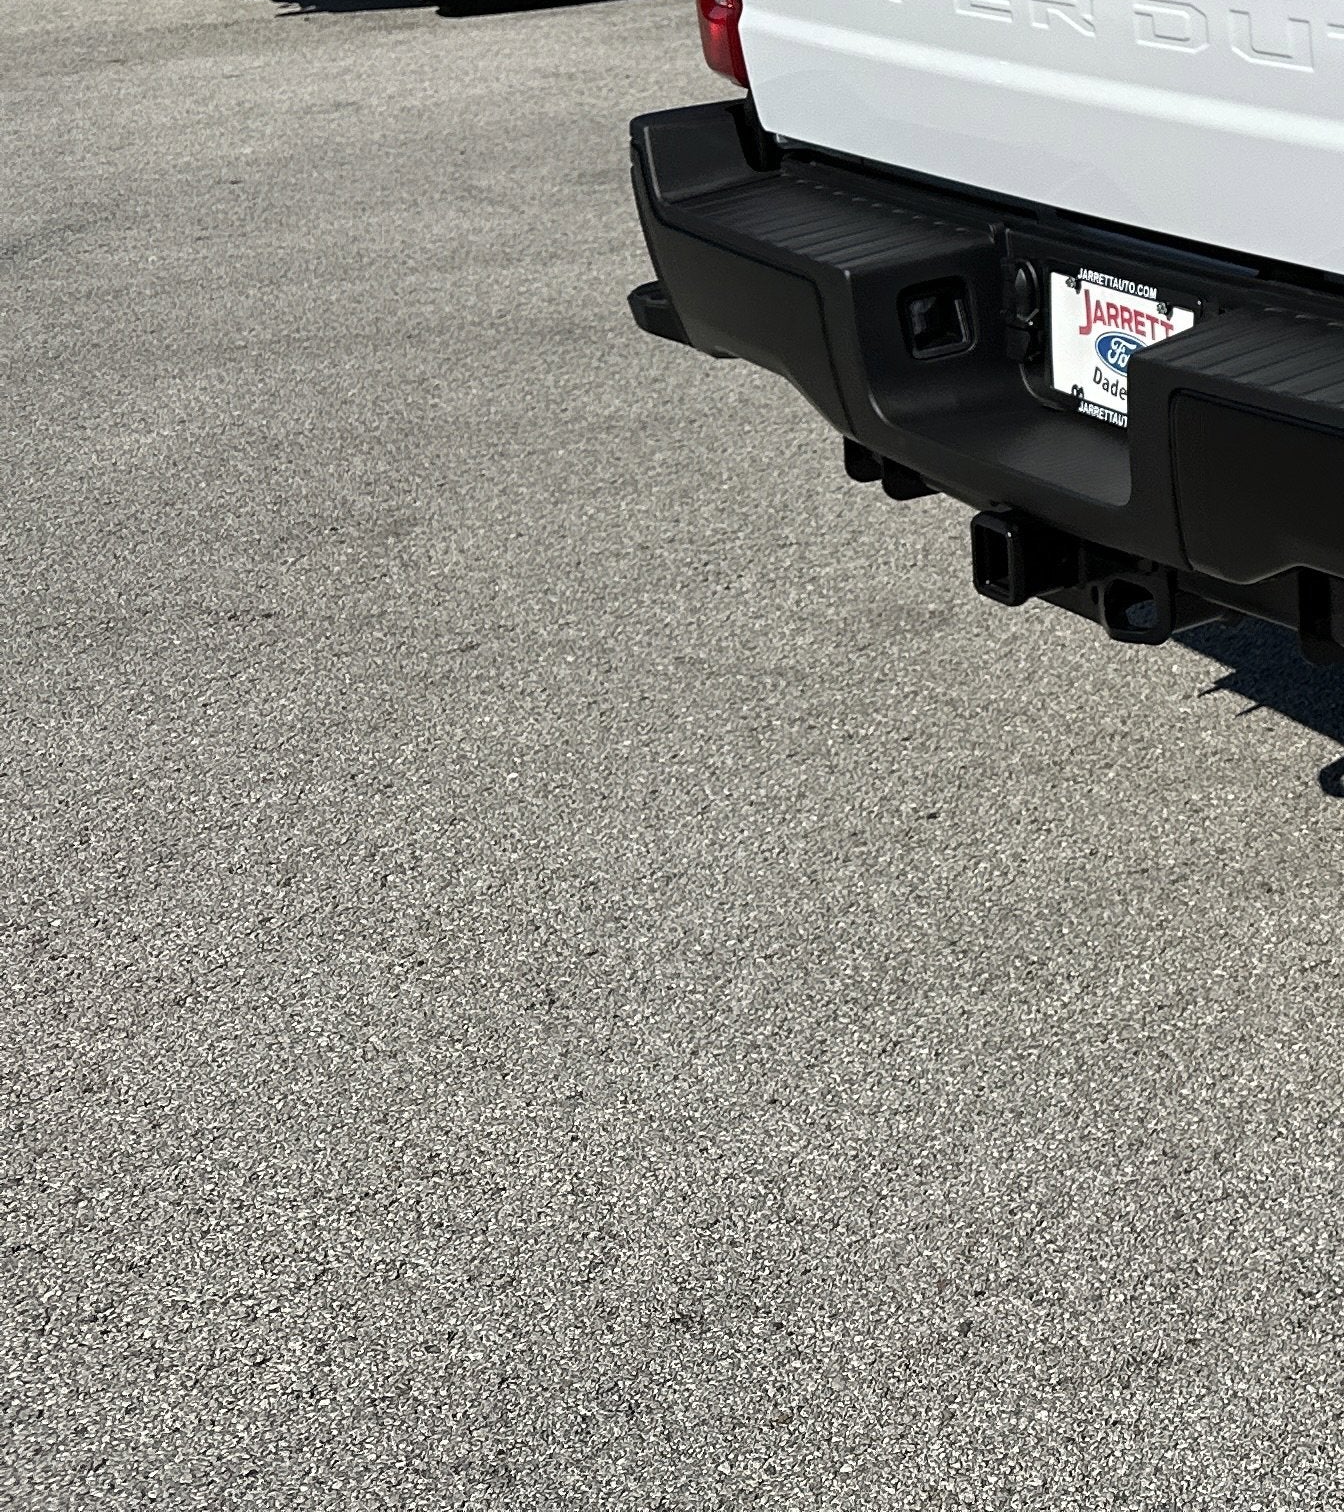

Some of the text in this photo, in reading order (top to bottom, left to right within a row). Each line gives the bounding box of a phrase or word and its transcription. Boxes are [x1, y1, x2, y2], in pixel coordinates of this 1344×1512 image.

[1077, 268, 1157, 299] JARRETTAUTO.COM
[1079, 289, 1174, 341] JARRETT
[1107, 337, 1136, 368] Fo
[1093, 366, 1128, 401] Dade
[1078, 400, 1128, 428] JARRETTAUT
